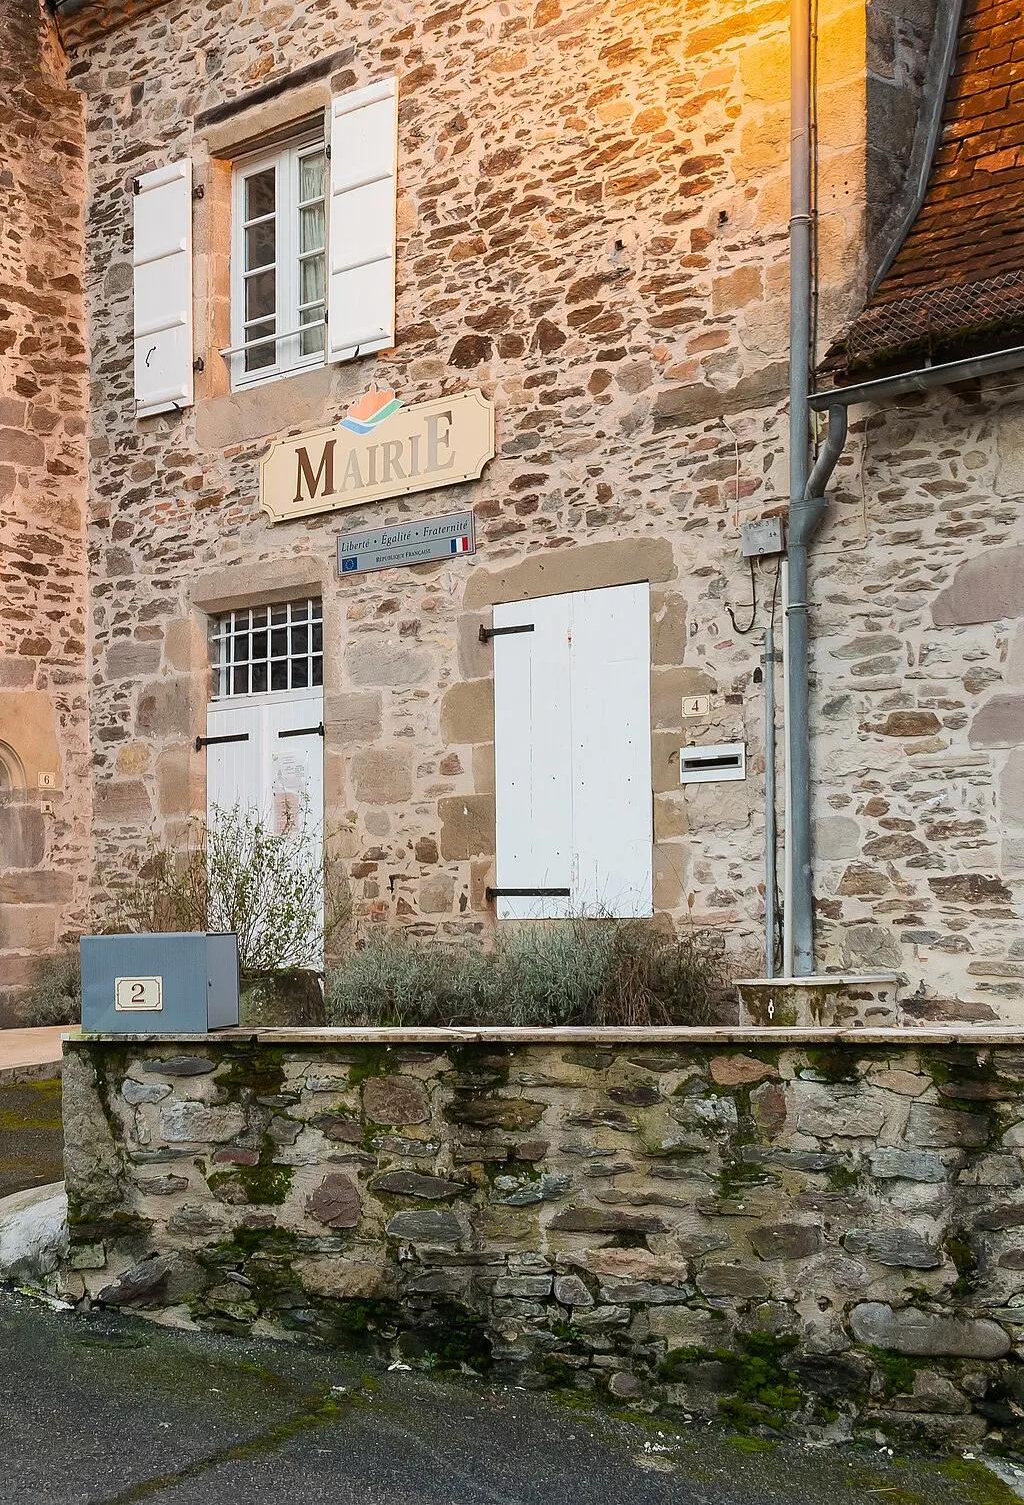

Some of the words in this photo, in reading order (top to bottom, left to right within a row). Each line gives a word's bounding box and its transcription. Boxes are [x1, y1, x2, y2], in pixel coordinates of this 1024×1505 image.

[293, 410, 456, 503] MAIRIE
[341, 539, 370, 552] Liberté
[381, 531, 412, 546] Égalité
[423, 520, 468, 537] Fraternité
[405, 549, 431, 557] FRANÇAISE
[691, 699, 699, 712] 4
[44, 774, 50, 785] 6
[131, 983, 145, 1003] 2
